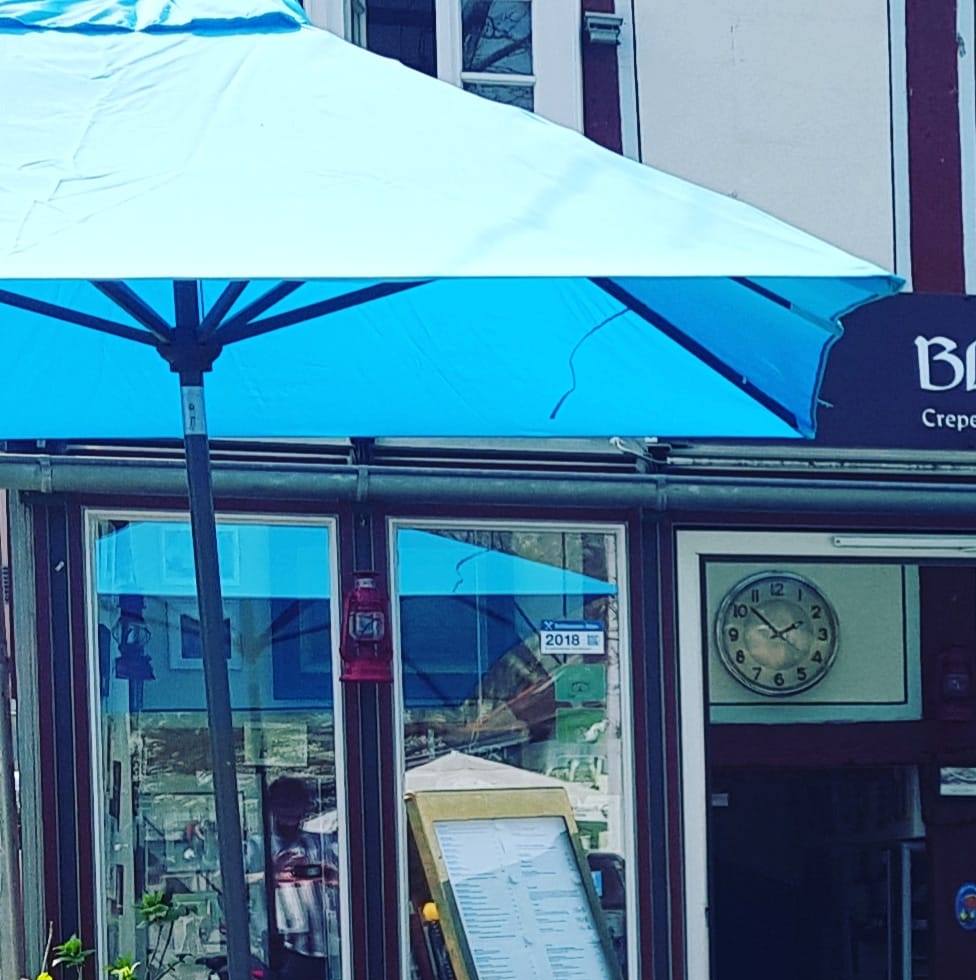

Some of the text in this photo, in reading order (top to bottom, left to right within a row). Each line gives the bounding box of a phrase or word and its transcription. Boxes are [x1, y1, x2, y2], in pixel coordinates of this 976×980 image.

[751, 589, 760, 602] 11
[769, 583, 785, 597] 12
[733, 604, 749, 618] 10
[811, 605, 822, 619] 2
[545, 633, 580, 646] 2018
[728, 627, 739, 641] 9
[817, 627, 828, 641] 3
[736, 649, 745, 664] 8
[811, 650, 822, 664] 4
[752, 667, 762, 680] 7
[774, 672, 785, 686] 6
[797, 667, 807, 681] 5
